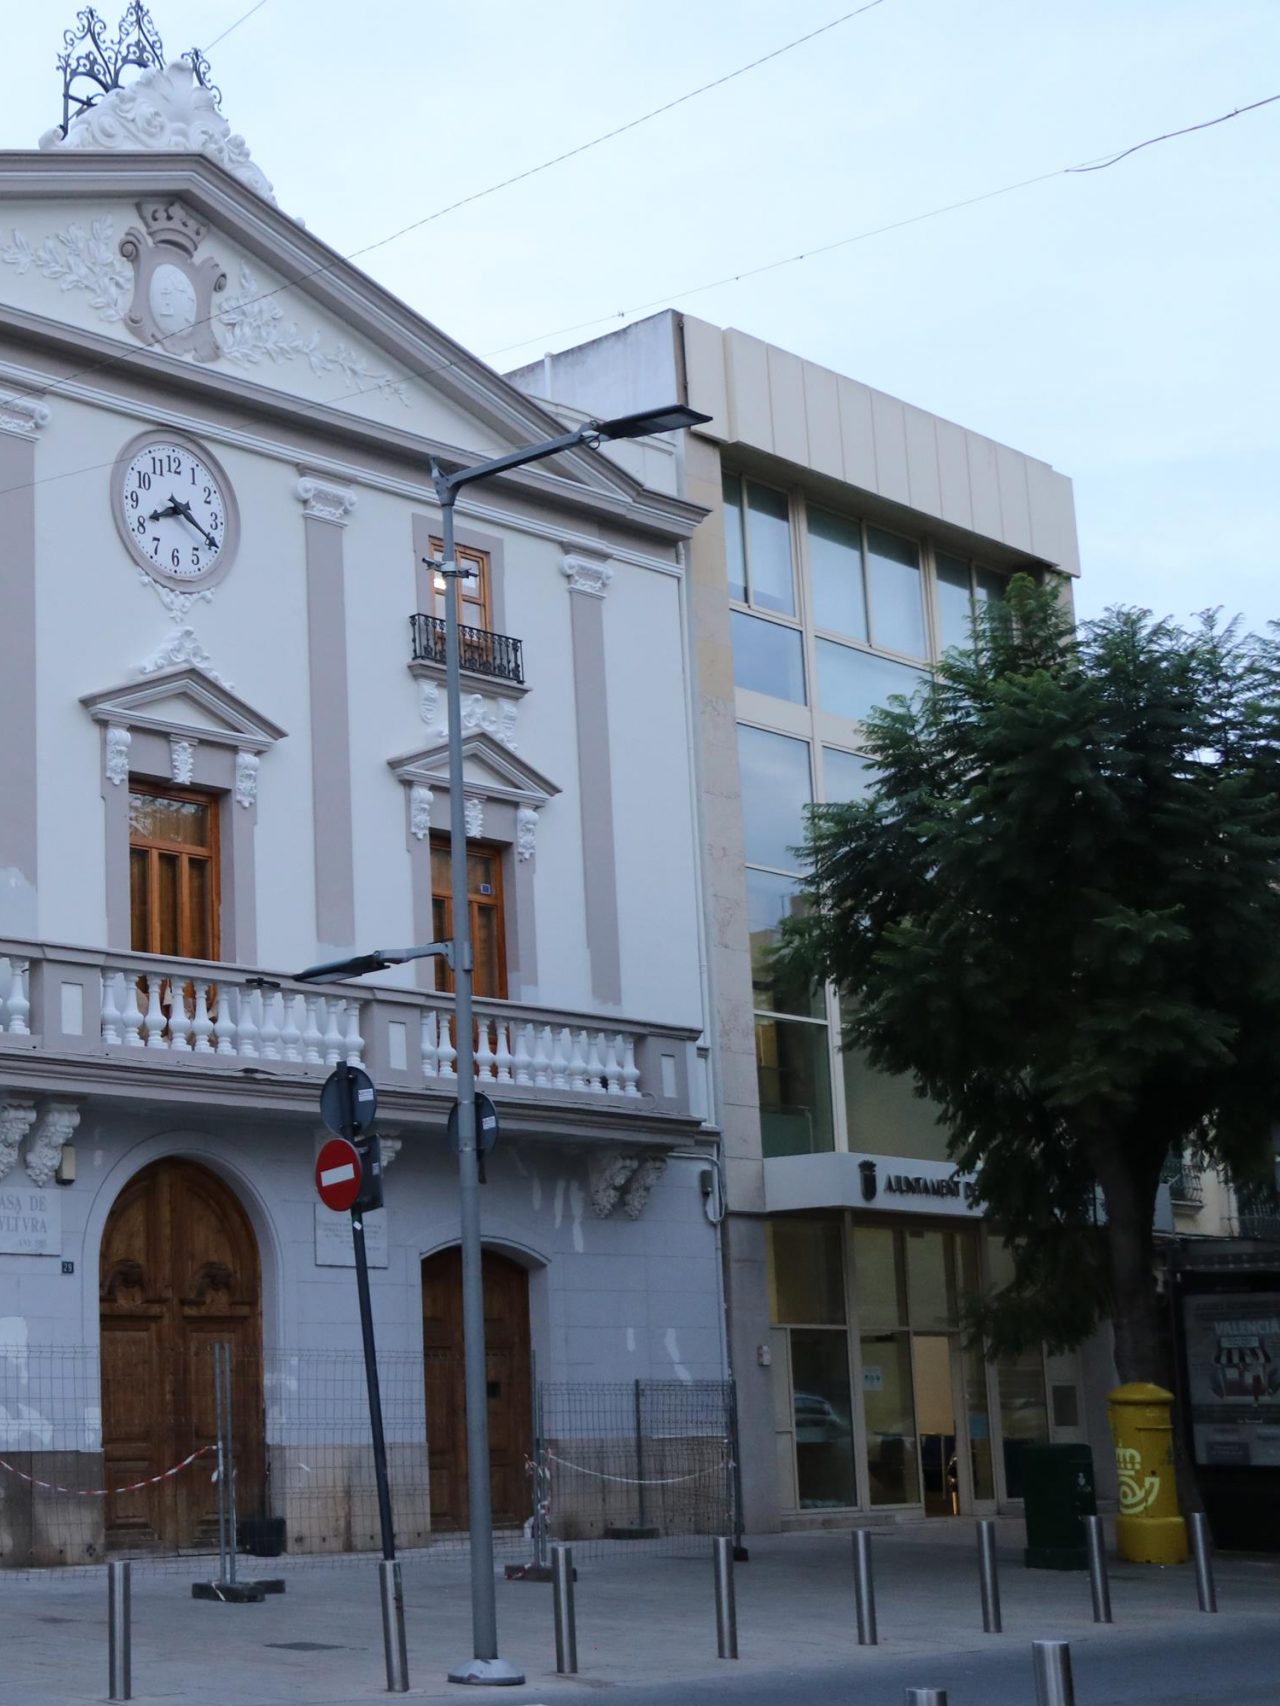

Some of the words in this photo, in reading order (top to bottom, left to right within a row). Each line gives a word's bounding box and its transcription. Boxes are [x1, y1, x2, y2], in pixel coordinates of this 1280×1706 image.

[151, 456, 164, 477] 11
[166, 455, 182, 476] 12
[137, 470, 151, 491] 10
[190, 467, 197, 486] 1
[130, 490, 139, 509] 9
[203, 486, 212, 505] 2
[137, 515, 146, 535] 8
[210, 512, 218, 531] 3
[152, 537, 161, 556] 7
[171, 548, 180, 567] 6
[191, 547, 200, 566] 5
[883, 1174, 961, 1198] AJUNTAMENT
[30, 1196, 47, 1212] DE
